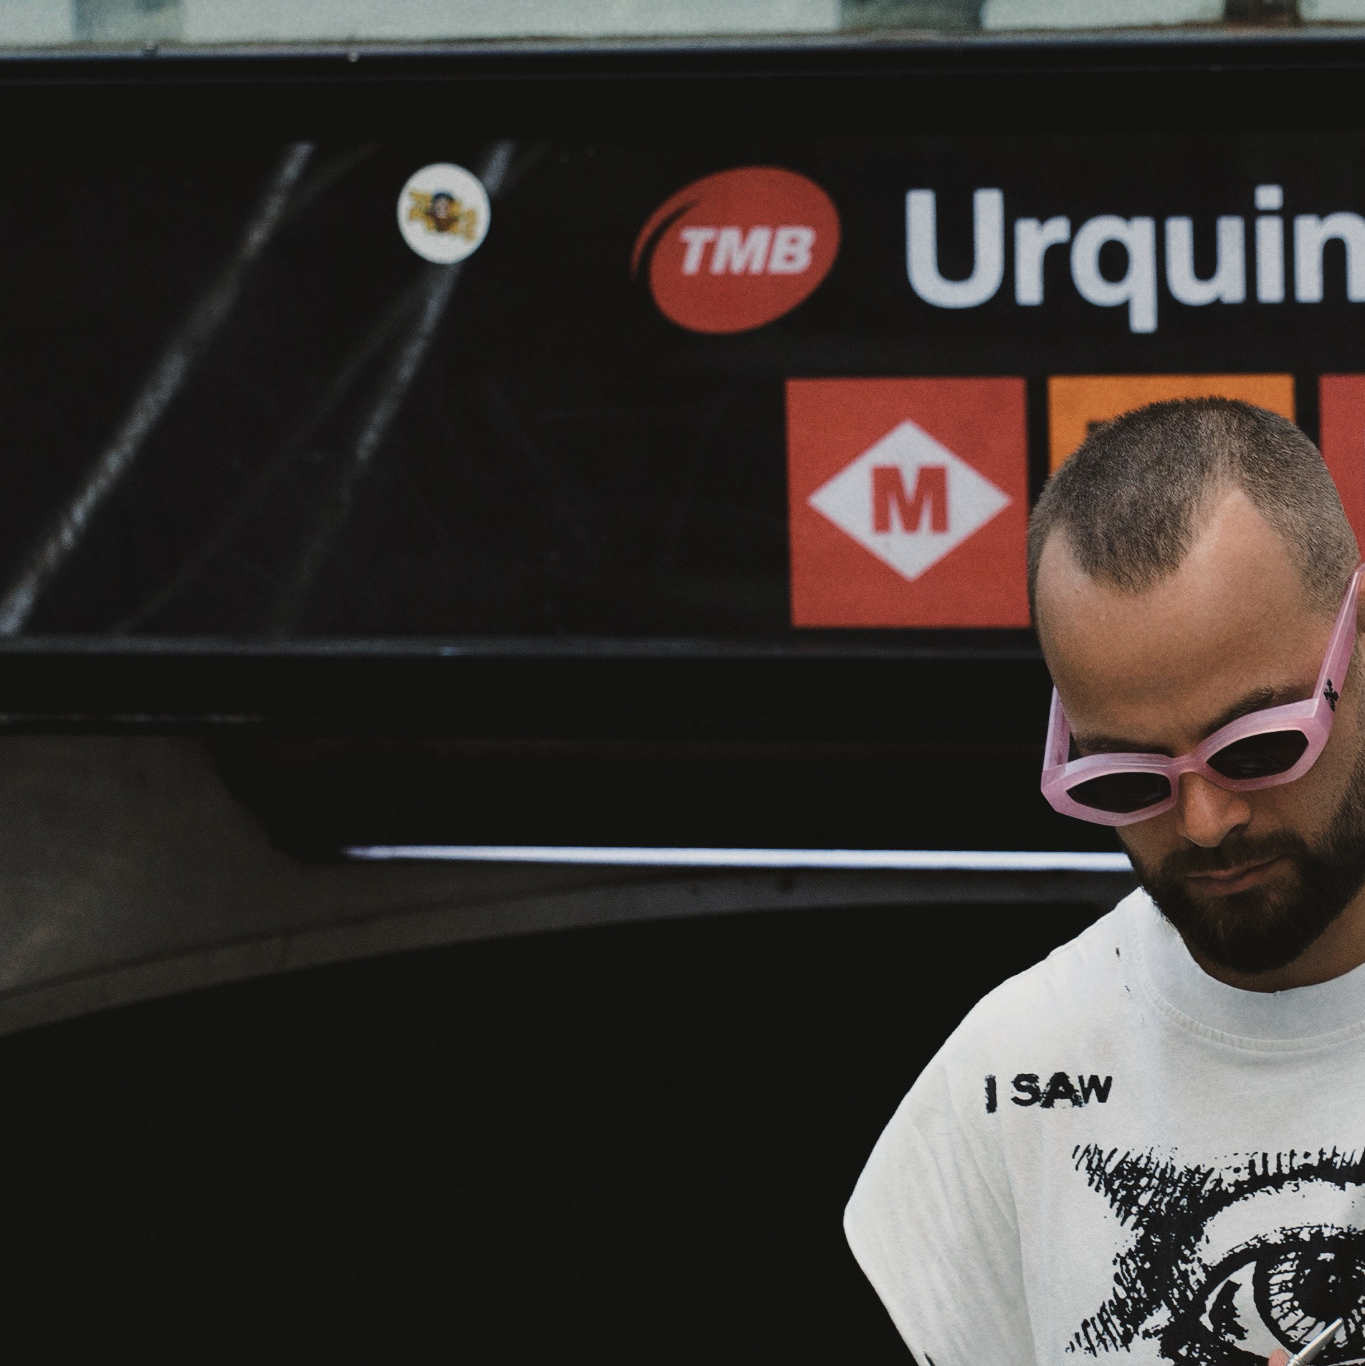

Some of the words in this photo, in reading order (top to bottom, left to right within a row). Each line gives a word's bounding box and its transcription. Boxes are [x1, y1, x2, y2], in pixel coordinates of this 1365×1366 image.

[680, 225, 817, 276] TMB
[871, 465, 950, 535] M
[984, 1074, 998, 1114] I
[1010, 1071, 1113, 1109] SAW
